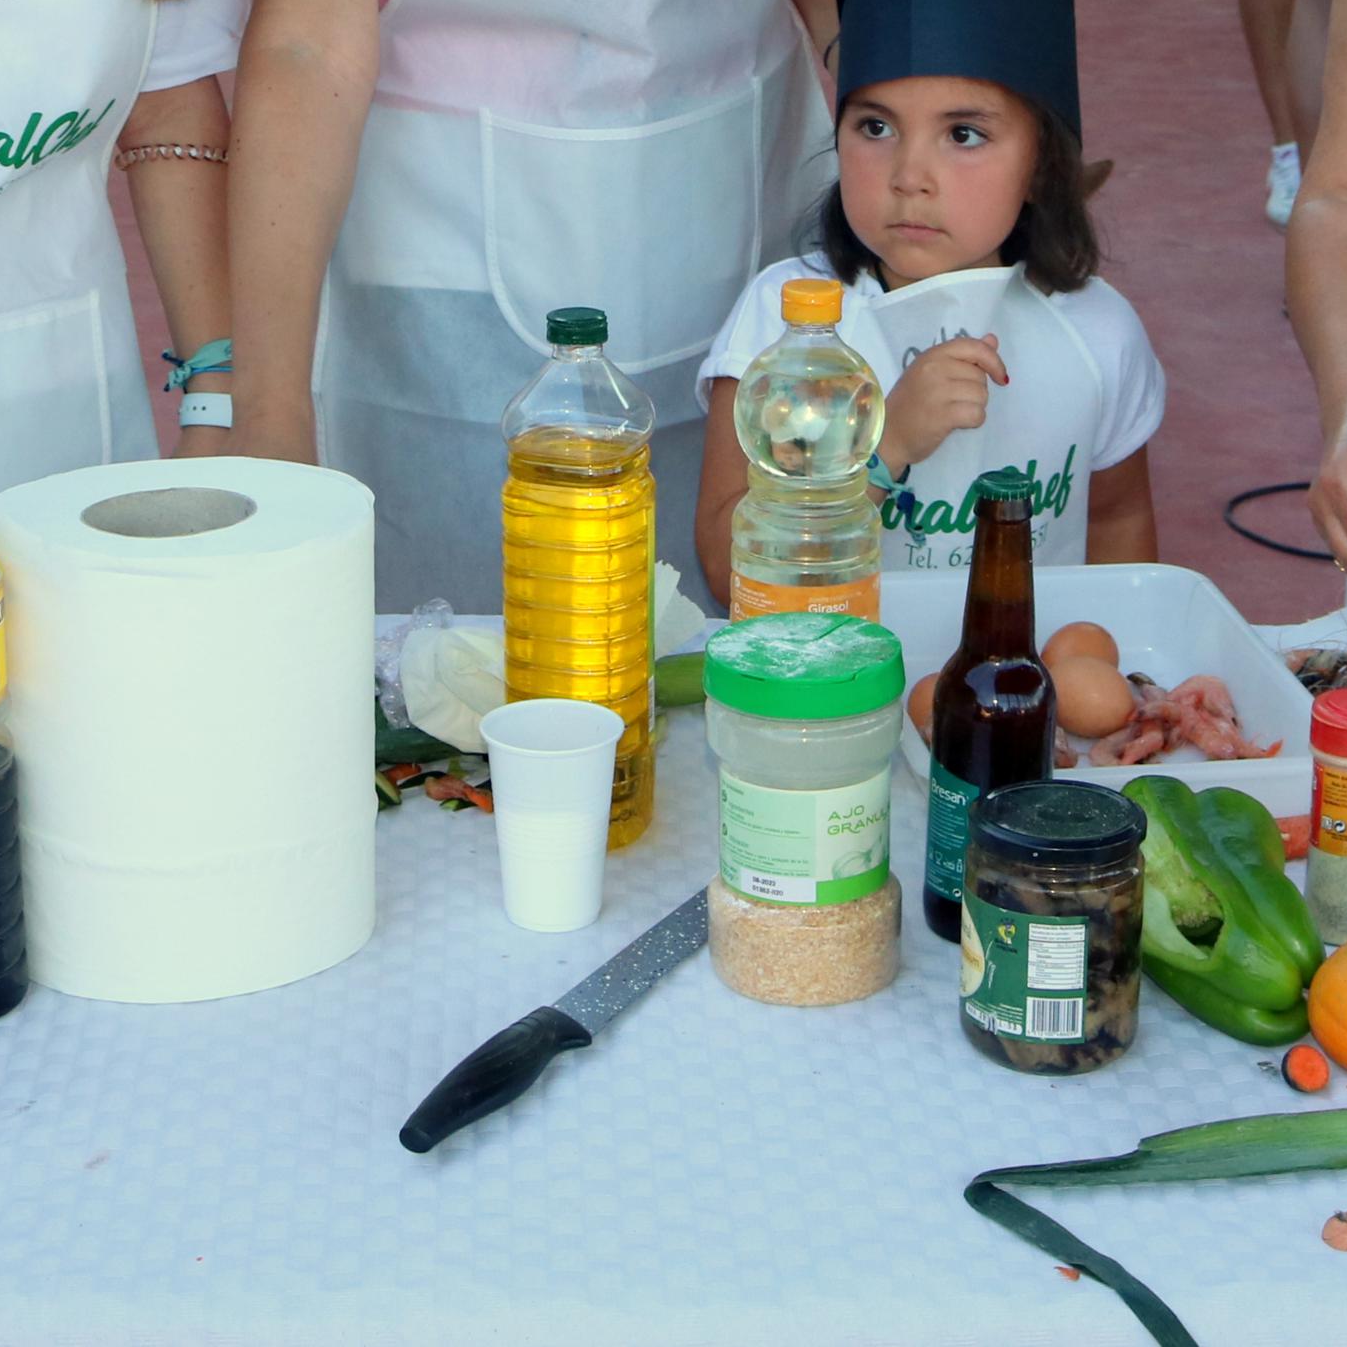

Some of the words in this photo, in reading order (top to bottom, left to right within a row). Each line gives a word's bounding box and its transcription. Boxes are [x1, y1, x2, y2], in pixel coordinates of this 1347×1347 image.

[904, 542, 939, 570] Tel.
[807, 600, 849, 613] Girasol
[827, 804, 865, 822] AJO
